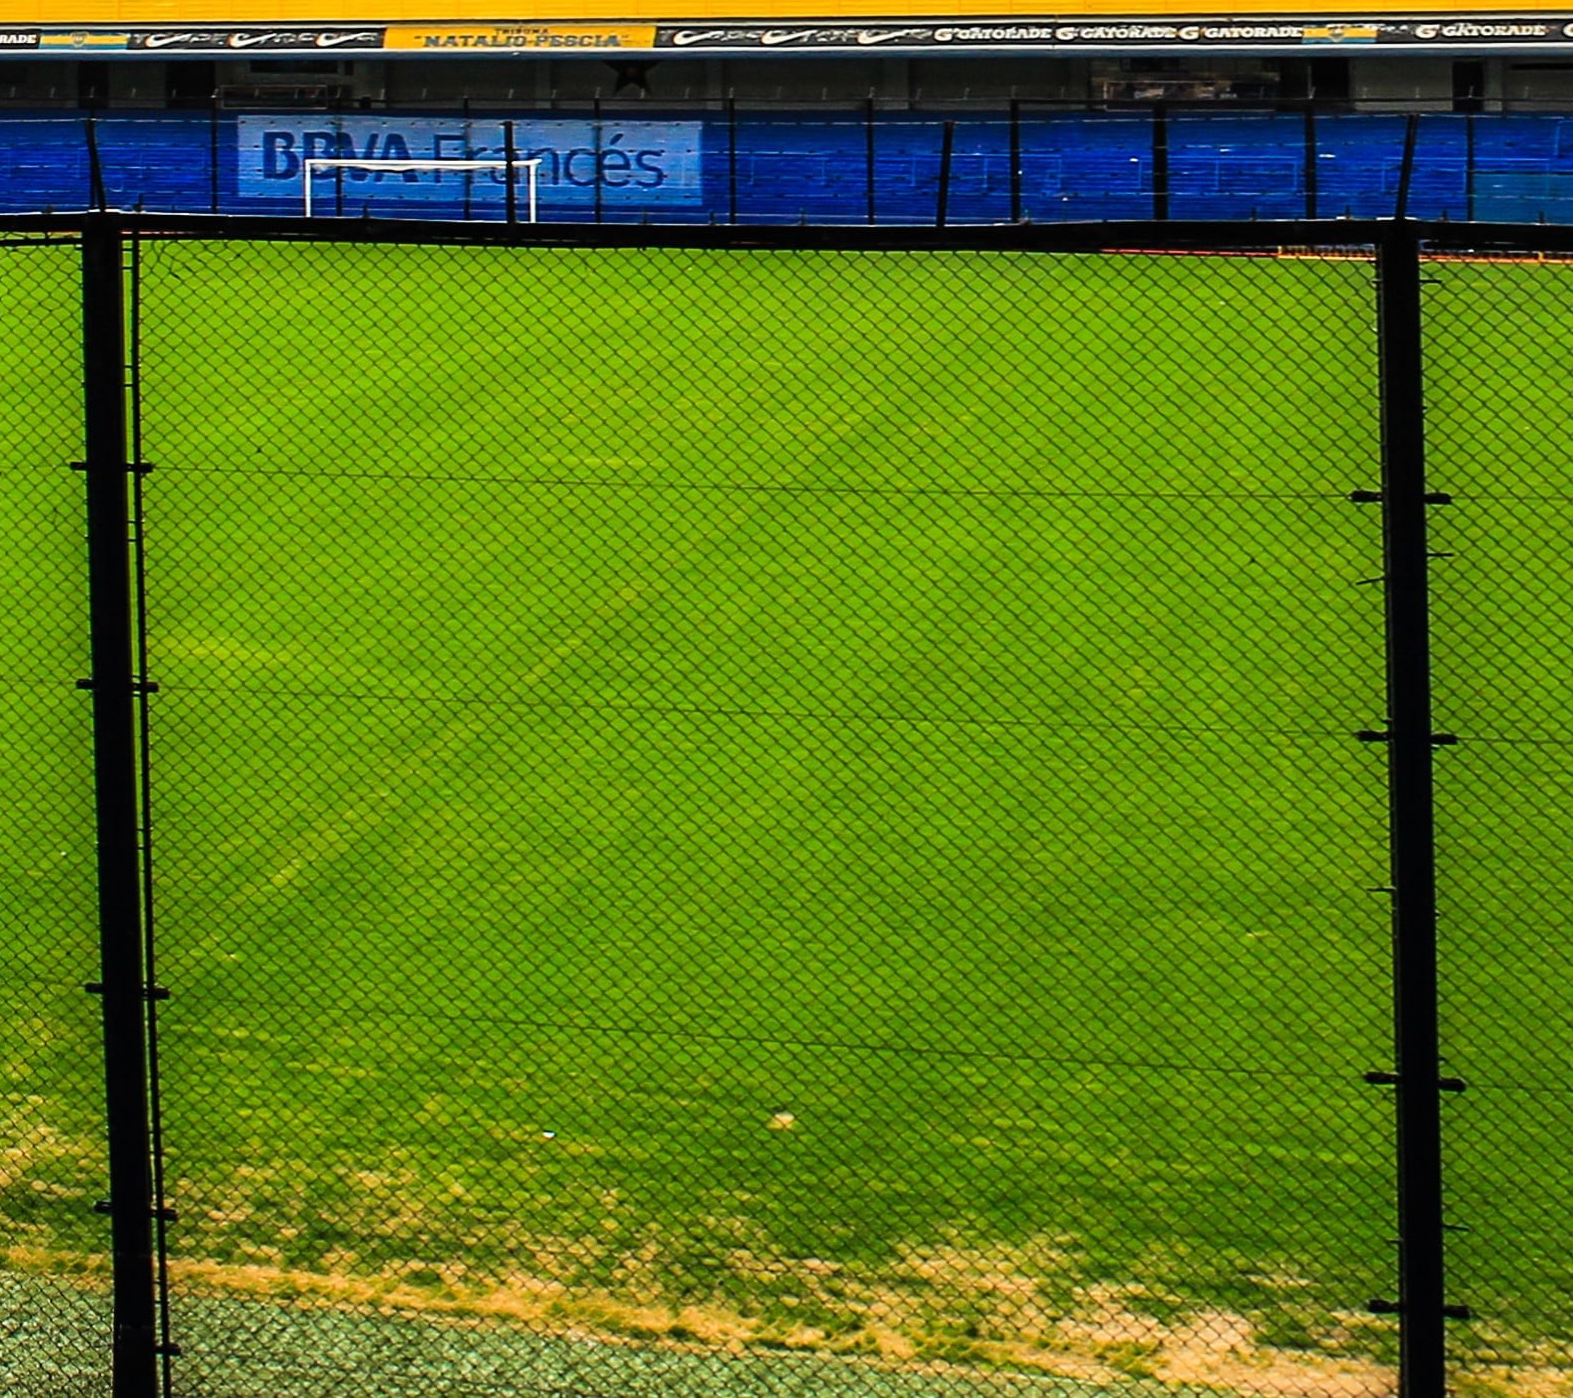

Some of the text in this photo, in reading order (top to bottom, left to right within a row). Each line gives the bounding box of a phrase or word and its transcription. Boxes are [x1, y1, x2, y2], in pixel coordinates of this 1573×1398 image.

[1206, 25, 1302, 39] GATORADE
[1442, 24, 1546, 37] GATORADE
[263, 131, 664, 187] BBVA Francés
